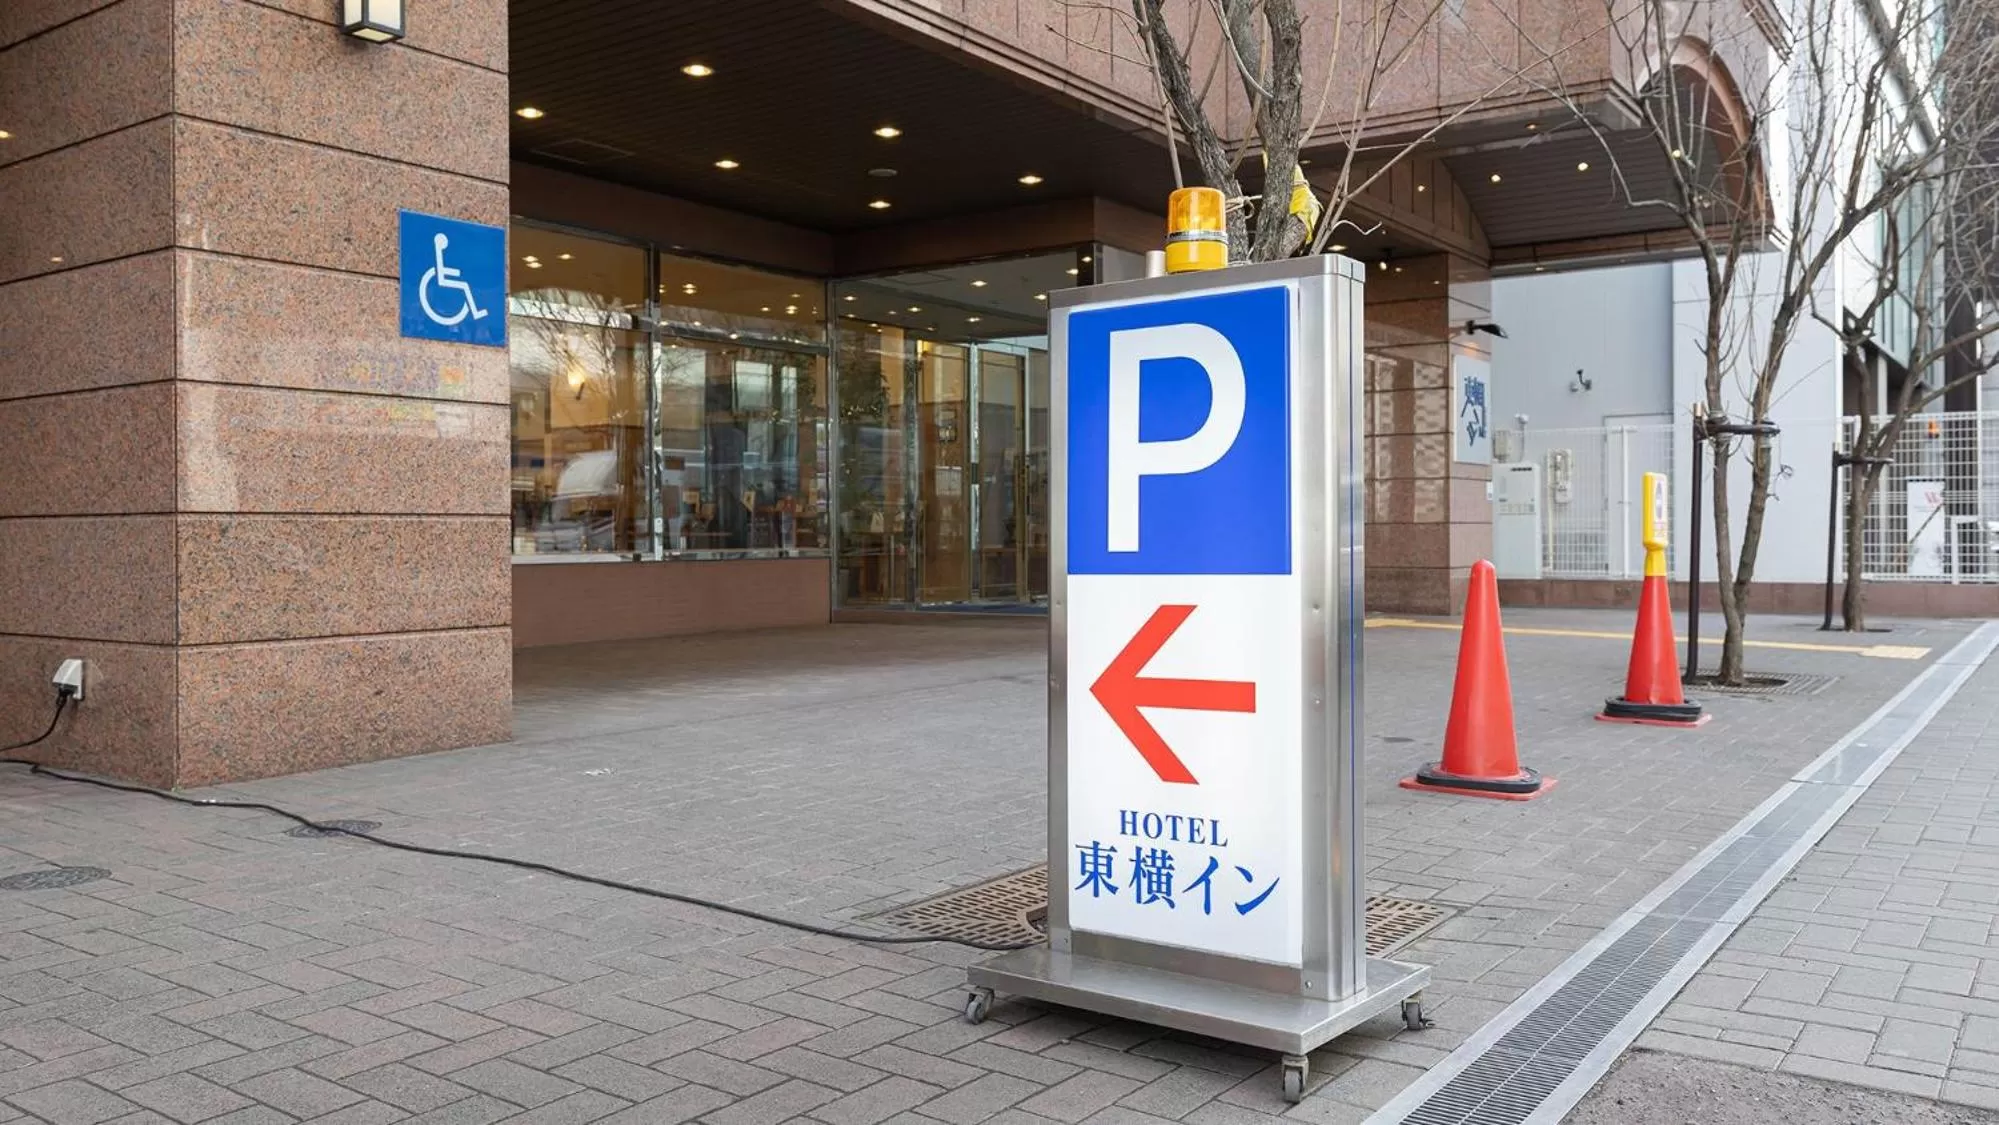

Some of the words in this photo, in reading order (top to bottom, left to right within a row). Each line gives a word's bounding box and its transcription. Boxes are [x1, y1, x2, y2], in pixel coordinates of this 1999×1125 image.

[1107, 322, 1246, 553] P
[1119, 809, 1229, 848] HOTEL
[1074, 840, 1280, 916] 東横イン
